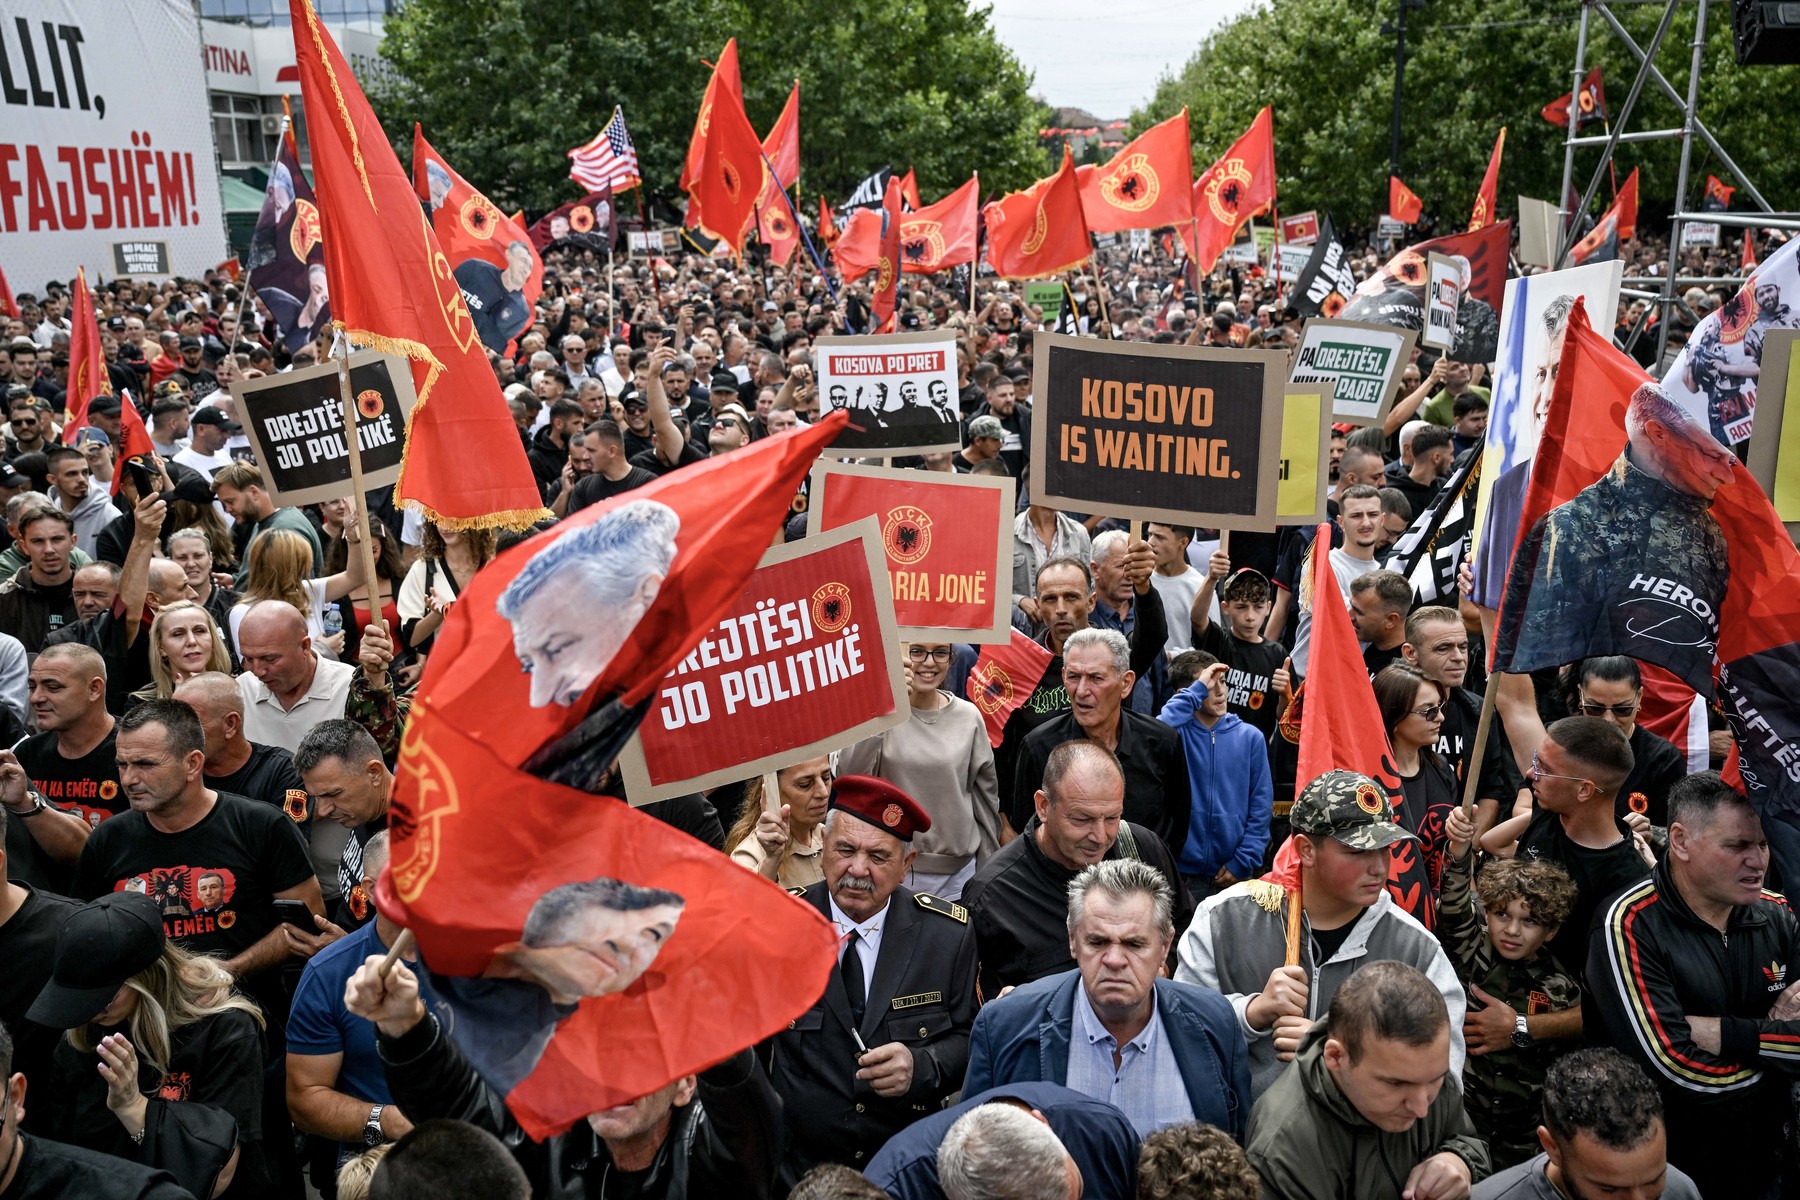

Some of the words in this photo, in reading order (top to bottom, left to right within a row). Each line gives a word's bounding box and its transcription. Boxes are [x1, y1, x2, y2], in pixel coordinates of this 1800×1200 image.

[0, 130, 199, 233] FAJSHËM!
[122, 243, 133, 253] NO
[134, 243, 158, 253] PEACE
[123, 253, 159, 263] WITHOUT
[127, 263, 159, 273] JUSTICE
[835, 356, 884, 374] KOSOVA
[887, 355, 906, 373] PO
[907, 353, 938, 371] PRET
[1298, 347, 1316, 367] PA
[1315, 346, 1383, 375] DREJTËSI,
[1082, 377, 1214, 427] KOSOVO
[1336, 378, 1381, 402] PAQE!
[276, 443, 304, 470] JO
[306, 413, 396, 464] POLTIKË
[1060, 423, 1086, 464] IS
[1094, 428, 1241, 480] WAITING.
[935, 570, 987, 605] JONË
[664, 598, 813, 679] REJTËSI
[661, 680, 710, 730] JO
[720, 623, 865, 715] POLITIKË
[1227, 668, 1251, 689] IRIA
[1252, 675, 1269, 693] KA
[1227, 685, 1250, 707] MËR
[49, 781, 63, 797] KA
[66, 778, 98, 798] EMËR
[1418, 811, 1443, 852] UÇ
[163, 921, 172, 938] A
[174, 914, 215, 937] EMËR
[1767, 982, 1786, 992] adida
